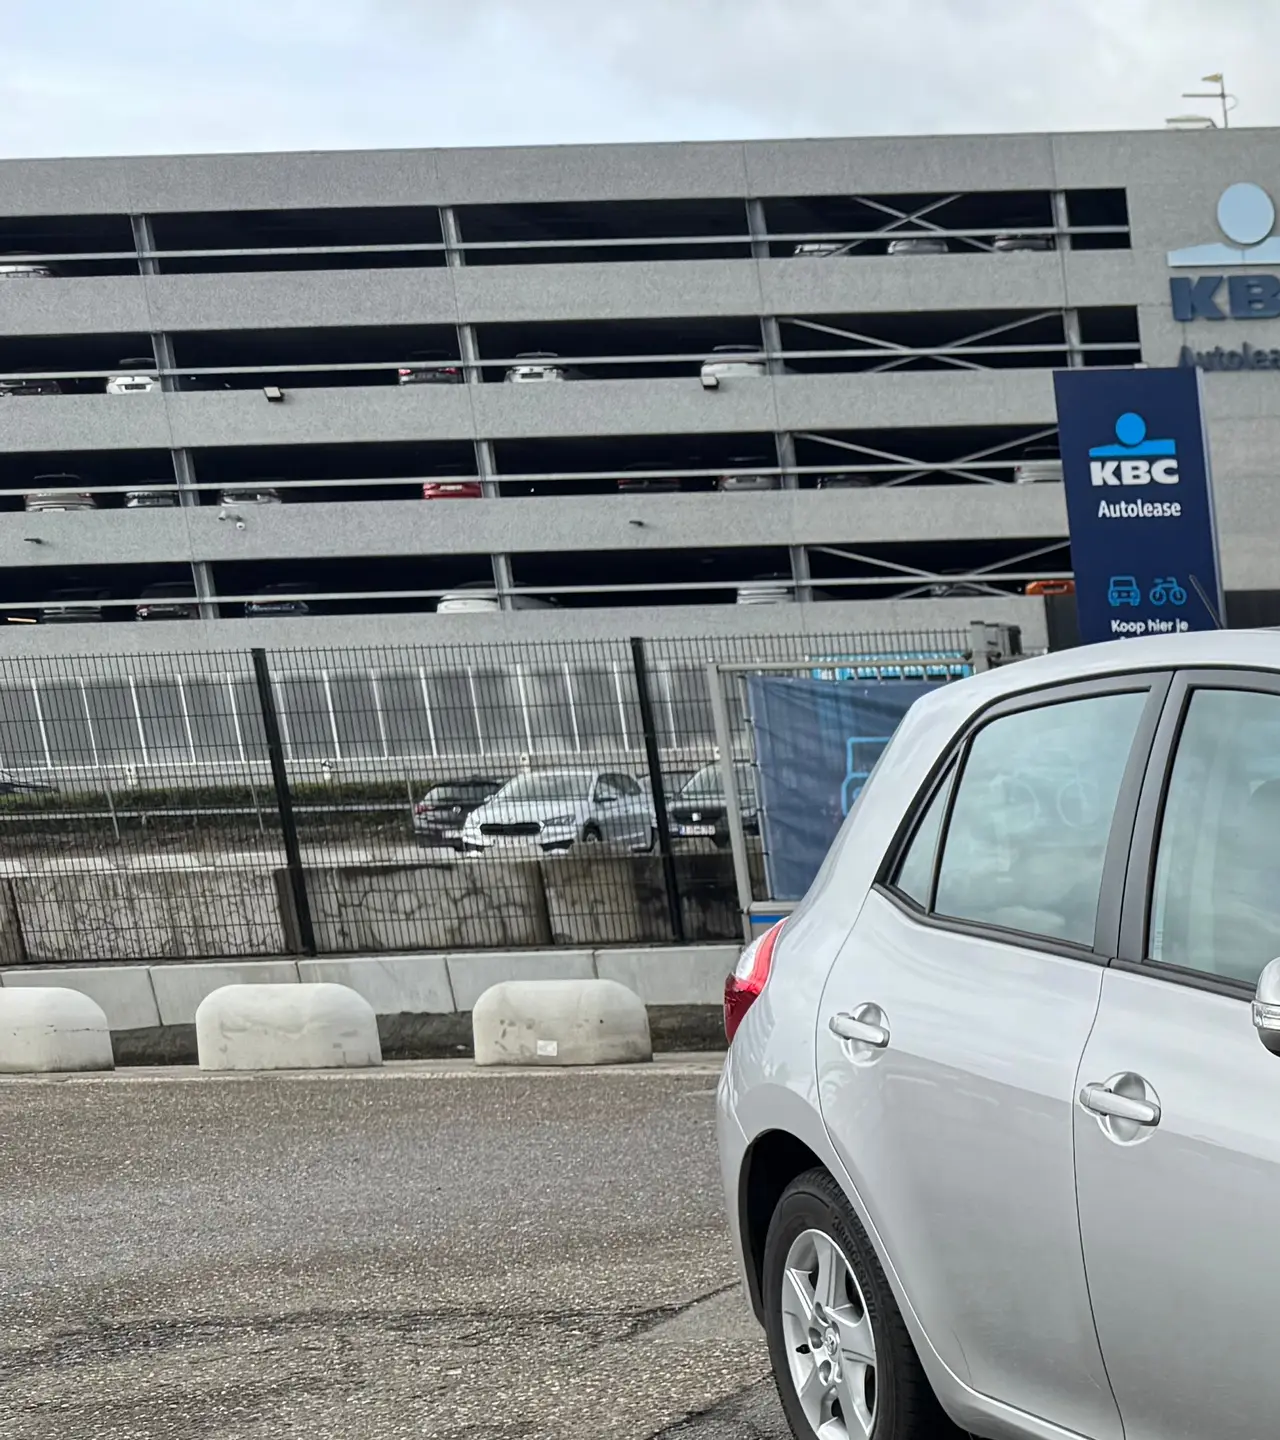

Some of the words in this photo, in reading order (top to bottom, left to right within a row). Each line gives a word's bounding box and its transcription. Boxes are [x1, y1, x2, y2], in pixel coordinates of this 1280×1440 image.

[1090, 459, 1180, 486] KBC
[1098, 498, 1182, 518] Autolease
[1111, 619, 1145, 634] Koop
[1148, 617, 1173, 632] hier
[1175, 618, 1189, 633] je
